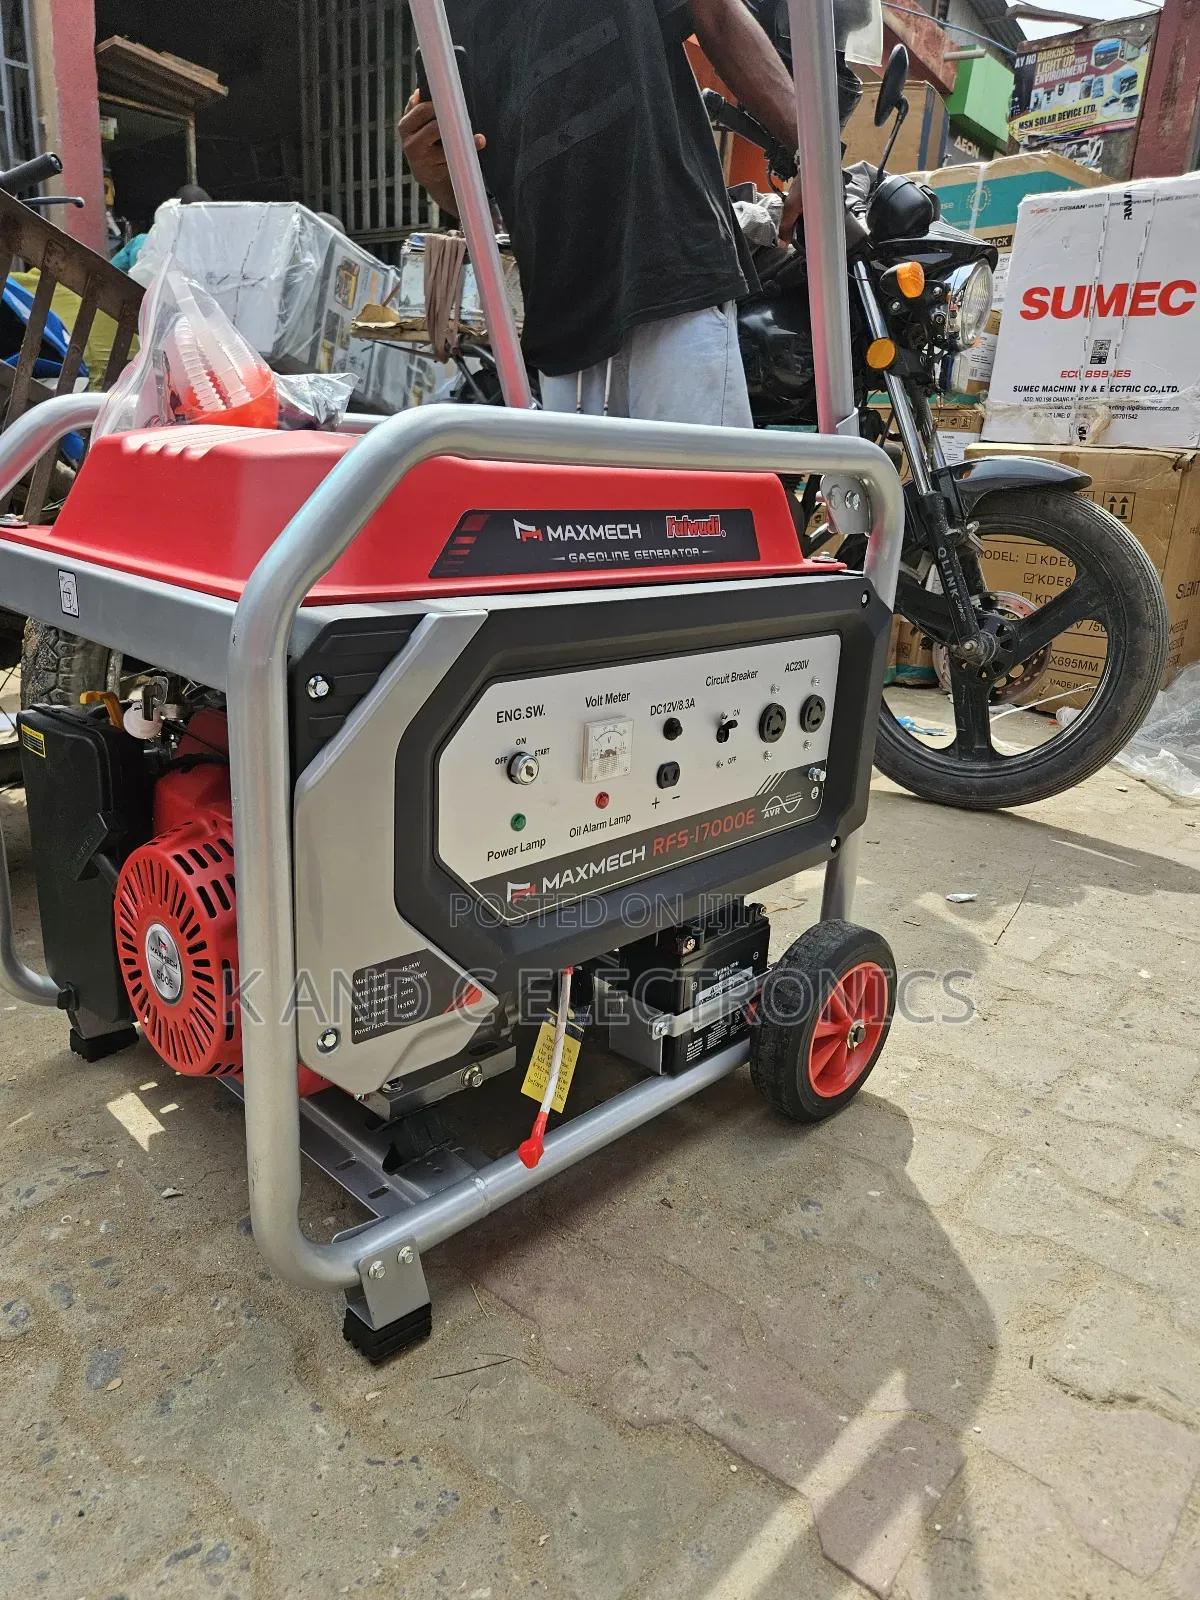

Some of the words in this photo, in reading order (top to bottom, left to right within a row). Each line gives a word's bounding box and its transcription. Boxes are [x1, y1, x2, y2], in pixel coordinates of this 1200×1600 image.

[1034, 63, 1088, 86] ENVIRONMENT
[1036, 61, 1060, 75] LIGHT
[1062, 56, 1075, 70] UP
[1018, 119, 1034, 130] MSN
[1034, 112, 1057, 127] SOLAR
[1057, 107, 1082, 122] DEVICE
[1019, 279, 1198, 321] SUMEC
[1012, 385, 1040, 393] SUMEC
[1090, 384, 1097, 393] &
[1099, 385, 1142, 393] EECTRIC
[1143, 385, 1180, 395] CO.,LTD.
[546, 523, 642, 542] MAXMECH
[568, 551, 630, 564] GASOLINE
[634, 547, 700, 560] GENERATOR
[784, 659, 811, 673] AC230V
[705, 674, 730, 687] Circuit
[730, 669, 759, 683] Breaker
[585, 695, 603, 708] Volt
[604, 691, 631, 705] Meter
[649, 697, 696, 717] DC12V/8.3A
[496, 704, 547, 724] ENG.SW.
[515, 737, 527, 746] ON
[494, 755, 508, 765] OFF
[534, 747, 551, 757] START
[569, 825, 582, 838] Oil
[582, 819, 608, 835] Alarm
[608, 813, 632, 827] Lamp
[487, 845, 519, 862] Power
[519, 837, 547, 852] Lamp
[542, 845, 646, 894] MAXMECH
[652, 807, 756, 857] RFS-17000E
[764, 807, 781, 820] AVR
[354, 1026, 371, 1036] Power
